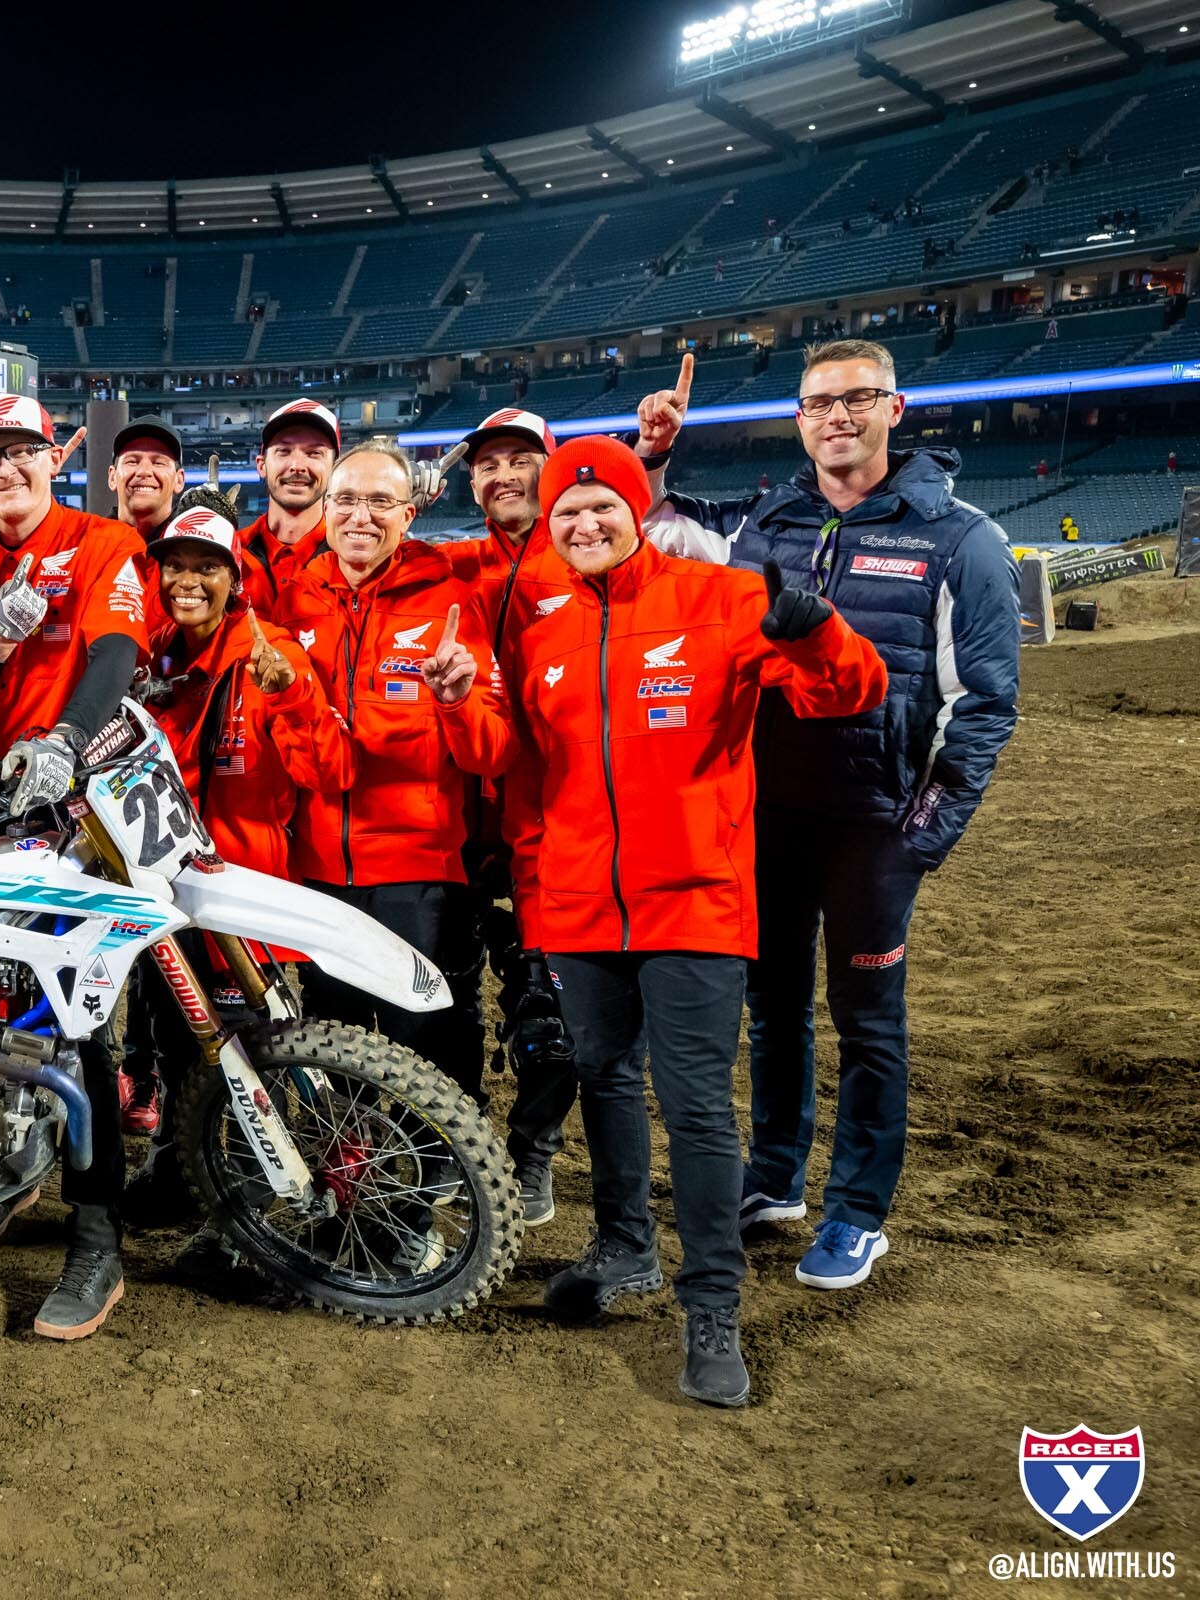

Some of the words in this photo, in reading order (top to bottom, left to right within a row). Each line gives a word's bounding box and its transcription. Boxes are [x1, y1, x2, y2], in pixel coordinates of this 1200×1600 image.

[863, 558, 917, 573] SHOWA
[1064, 556, 1138, 581] MONSTER
[644, 660, 687, 669] HONDA
[637, 675, 696, 696] HRC
[87, 727, 130, 766] RENTHAL
[123, 760, 192, 867] 23
[109, 920, 152, 937] HRC
[850, 944, 905, 967] SHOWA
[152, 942, 209, 1025] SHOWA
[424, 974, 443, 1003] HONDA
[228, 1076, 285, 1171] DUNLOP
